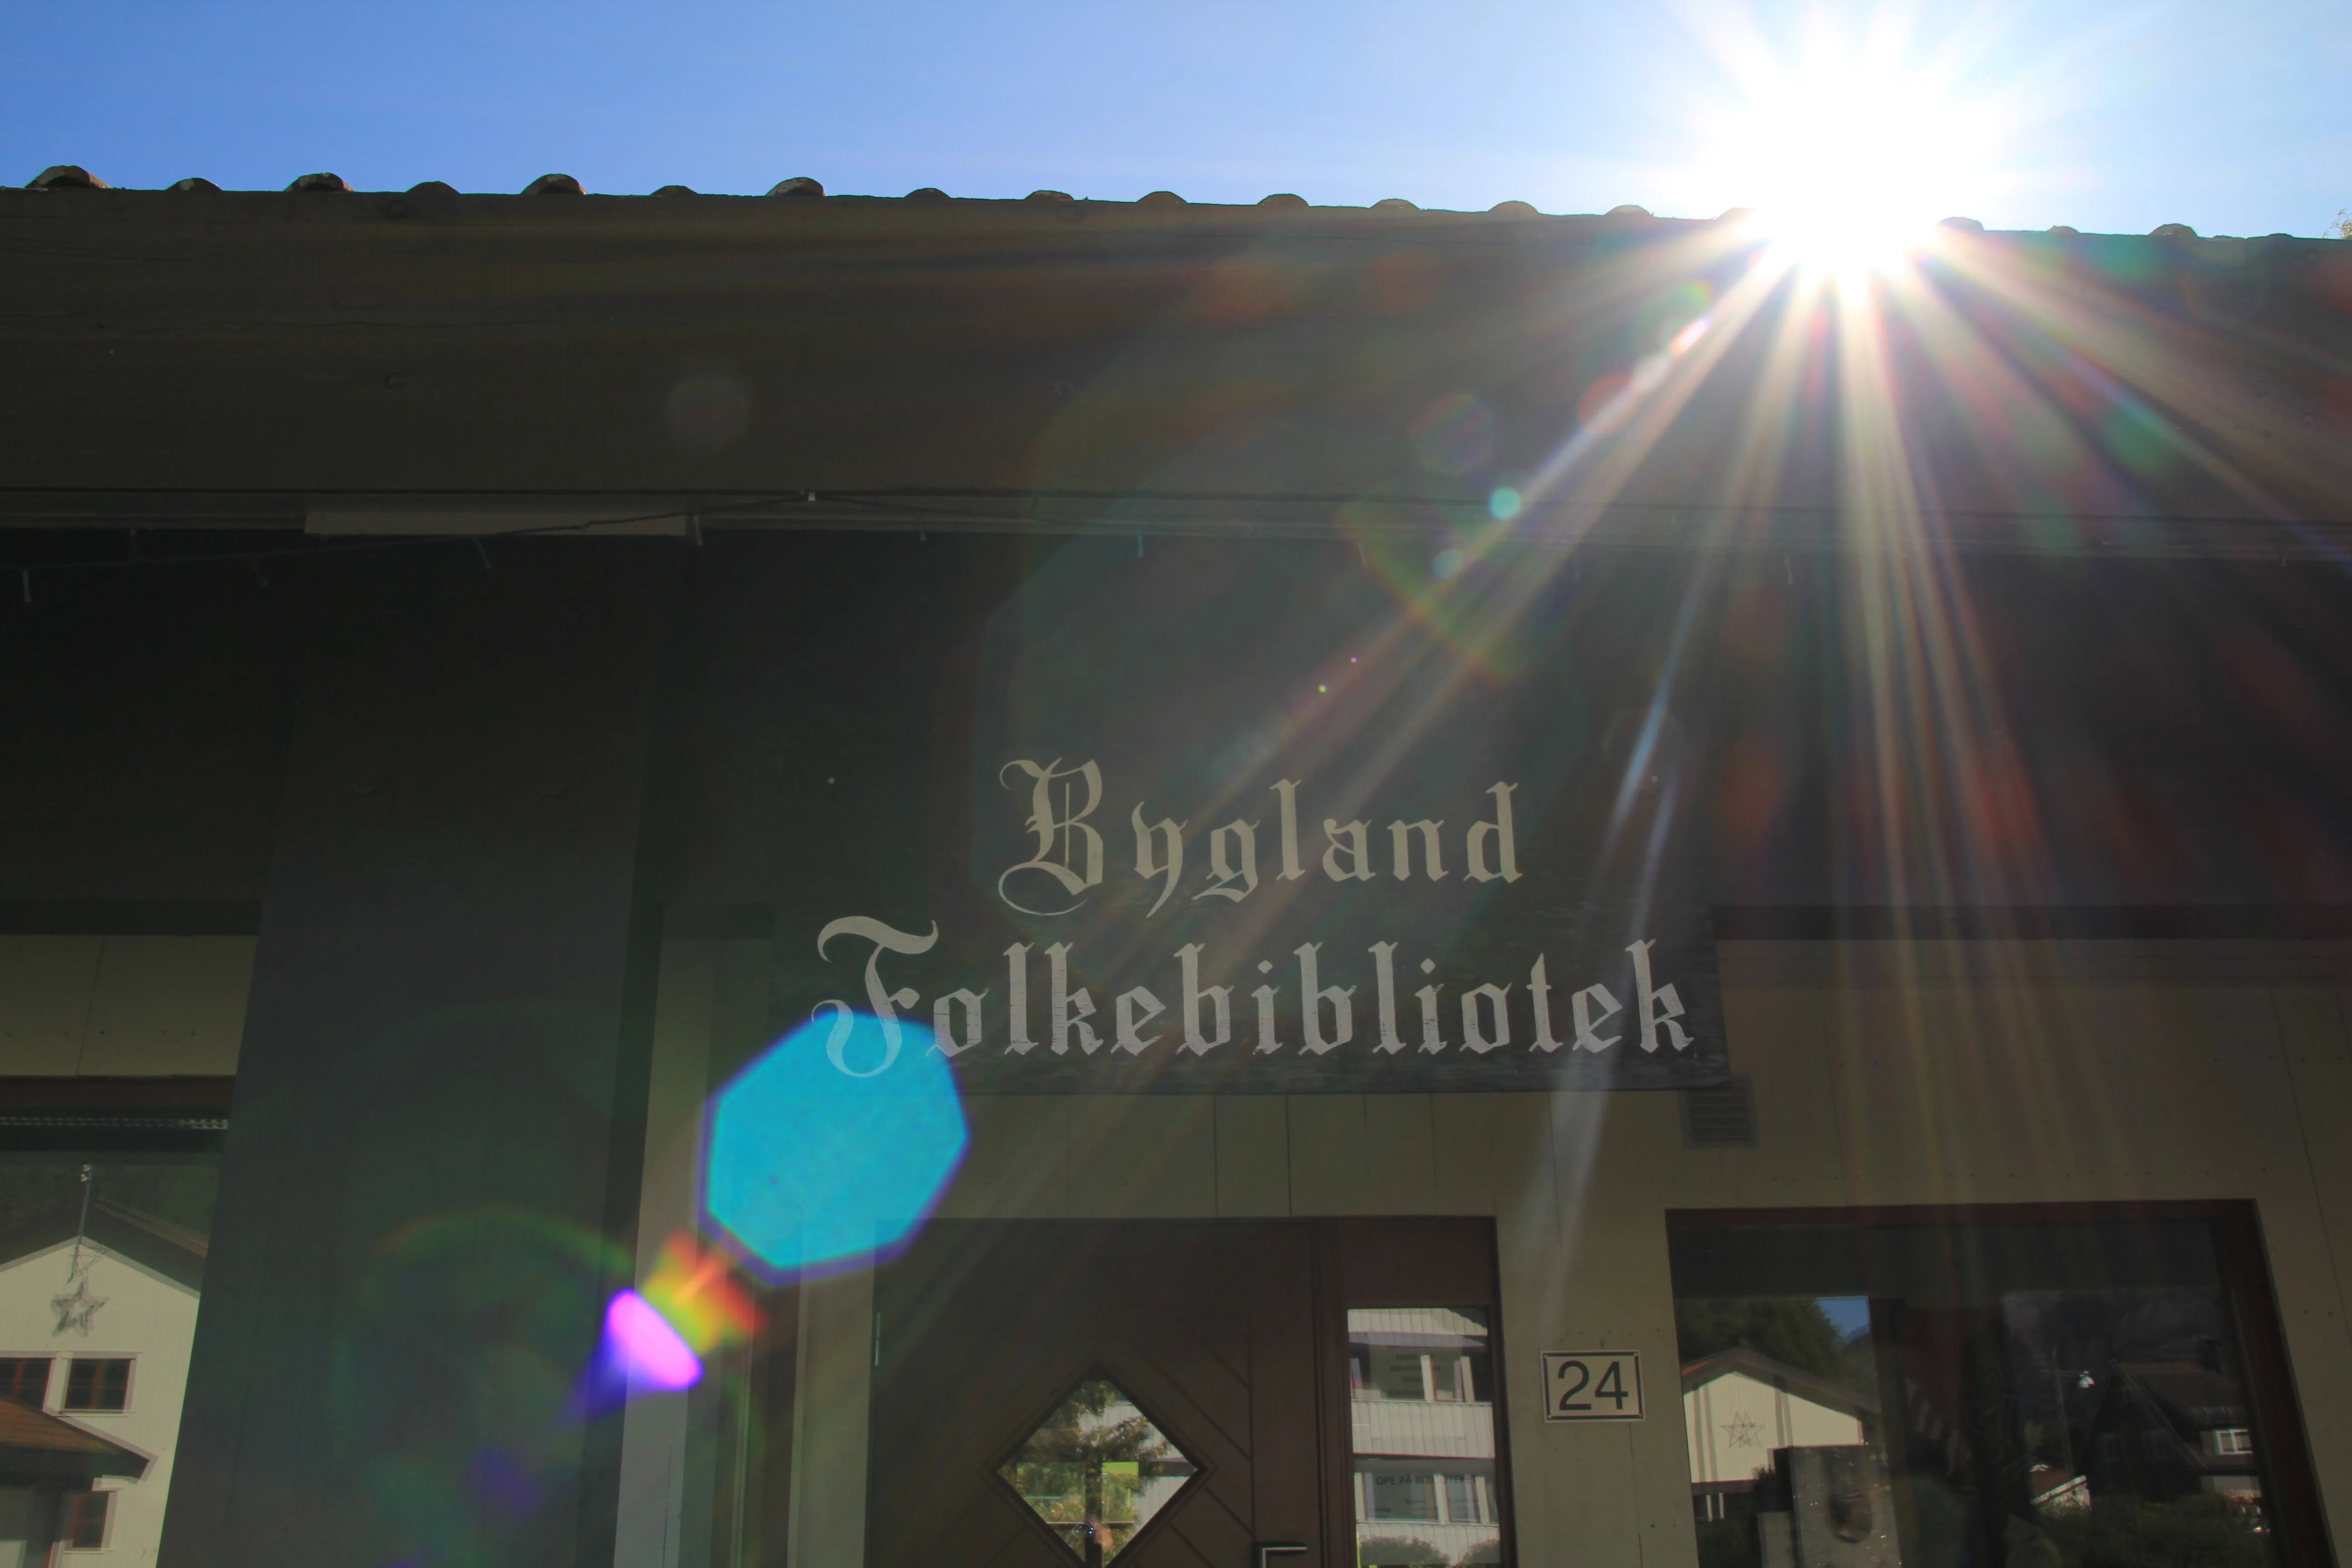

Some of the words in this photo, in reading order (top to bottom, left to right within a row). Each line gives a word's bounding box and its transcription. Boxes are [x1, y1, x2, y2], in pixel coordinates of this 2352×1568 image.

[999, 757, 1523, 918] Bygland
[811, 916, 1695, 1078] Folkebibliotek
[1557, 1360, 1629, 1411] 24
[1376, 1476, 1396, 1485] OPE
[1399, 1473, 1412, 1485] PÅ
[1415, 1475, 1478, 1485] BIBLOTEKET
